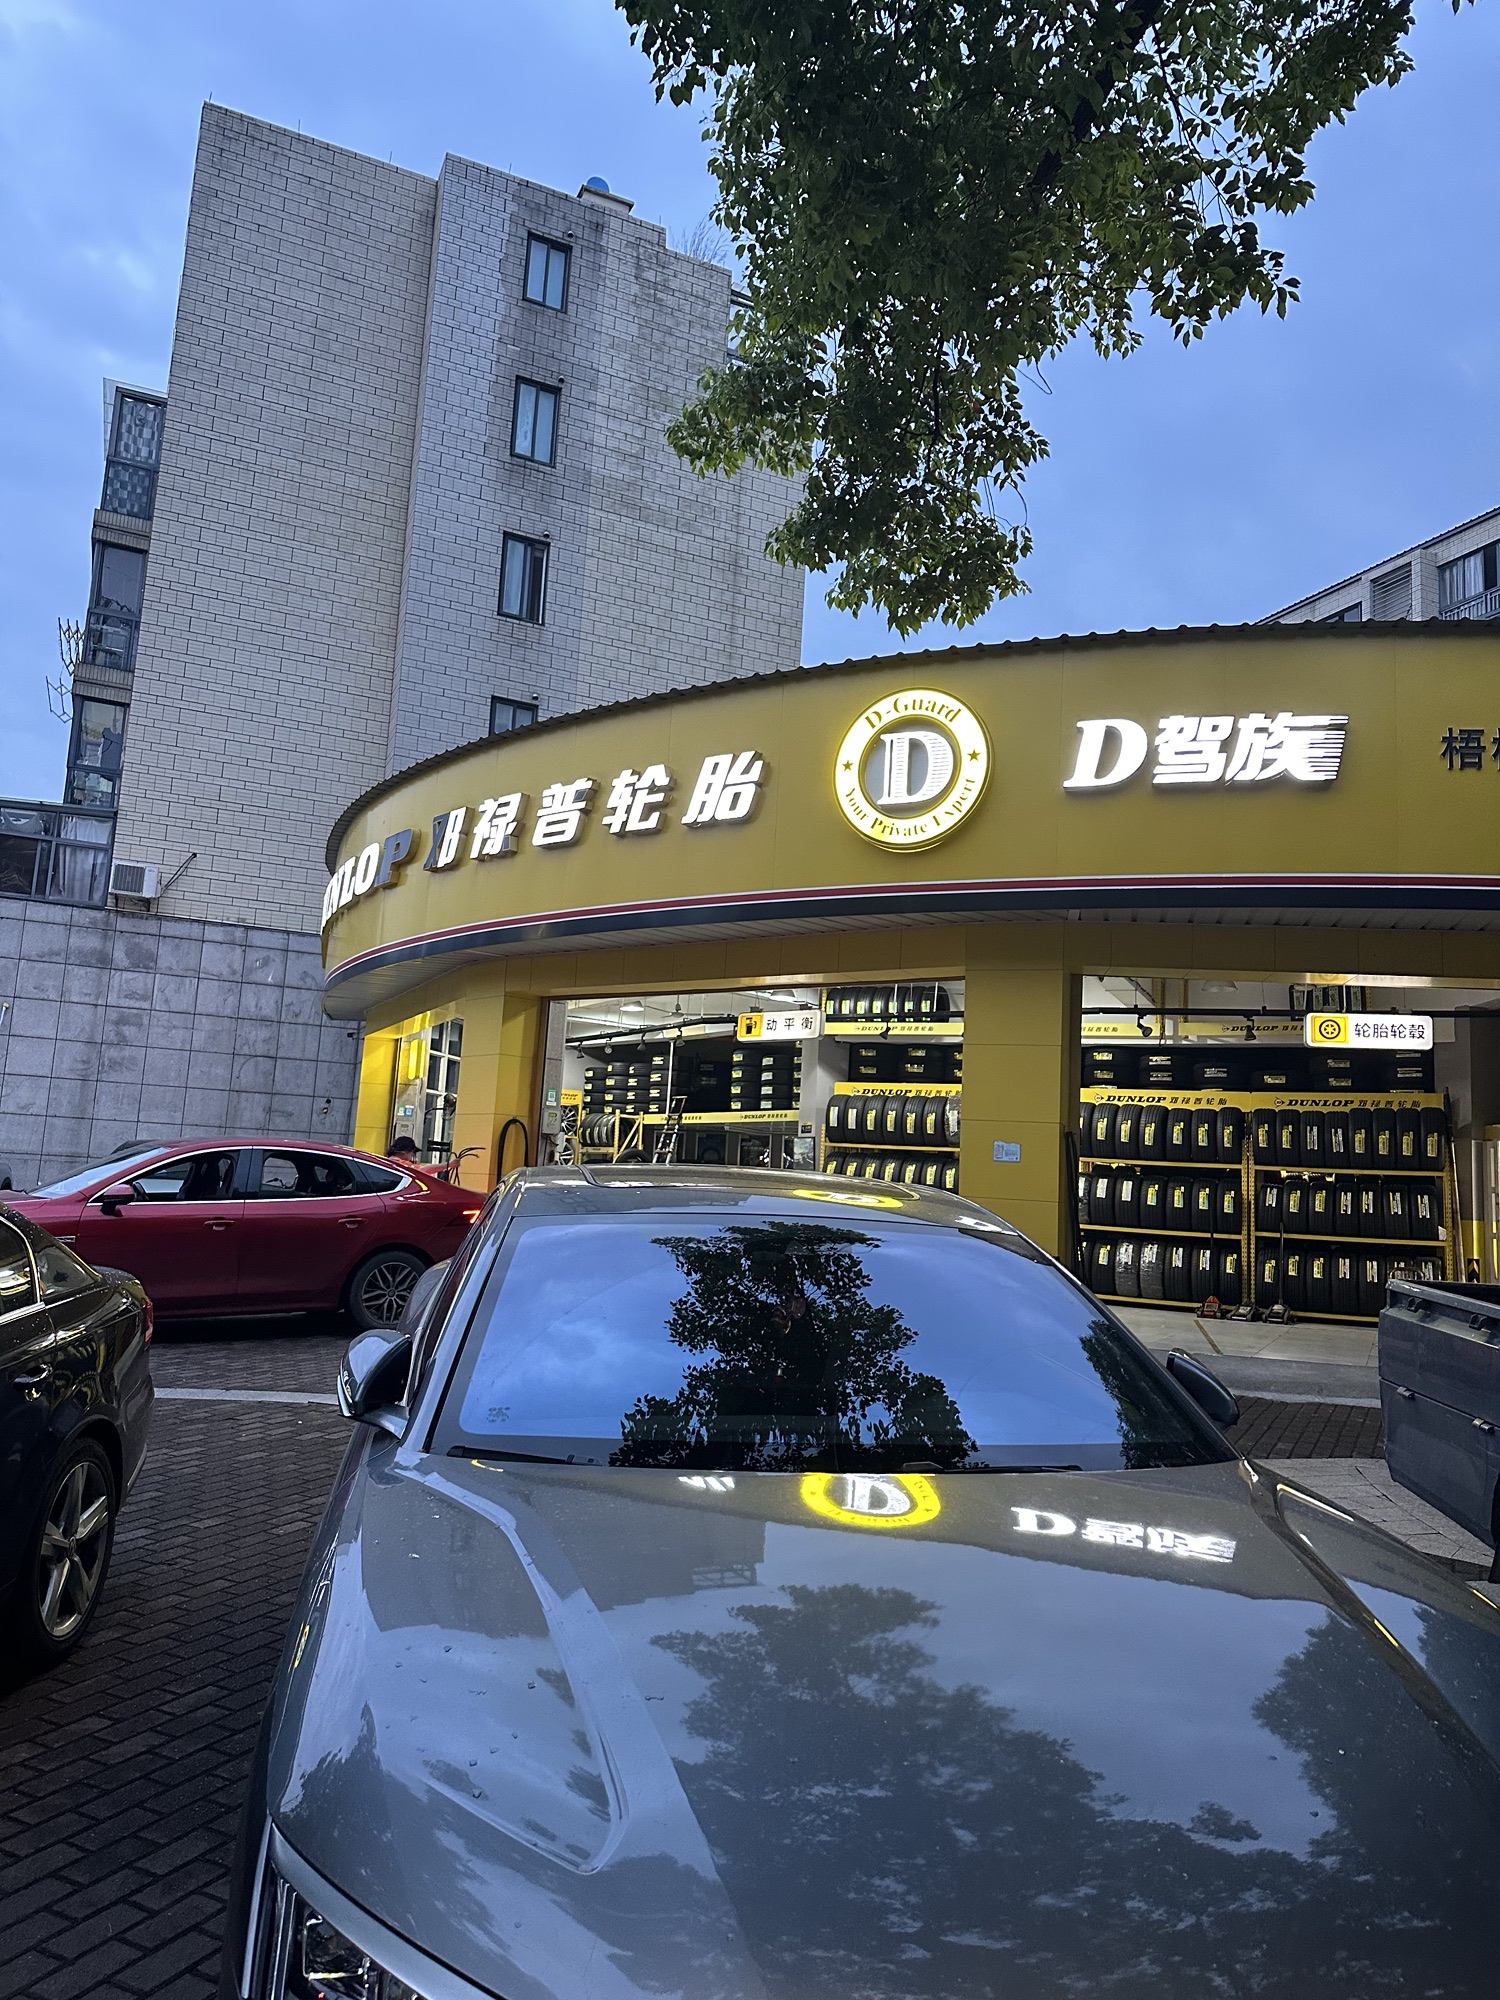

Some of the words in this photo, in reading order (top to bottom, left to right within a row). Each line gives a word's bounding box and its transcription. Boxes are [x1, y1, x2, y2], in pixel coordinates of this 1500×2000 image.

[864, 697, 962, 730] D-Guard
[877, 731, 954, 805] D
[423, 750, 765, 871] 邓禄普轮胎
[845, 788, 869, 821] Your
[870, 817, 928, 837] Private
[932, 778, 976, 827] Expert
[766, 1016, 813, 1032] 动平衡
[1354, 1023, 1426, 1040] 轮胎轮毂
[1105, 1095, 1167, 1104] DUNLOP
[1287, 1099, 1355, 1107] DUNLOP
